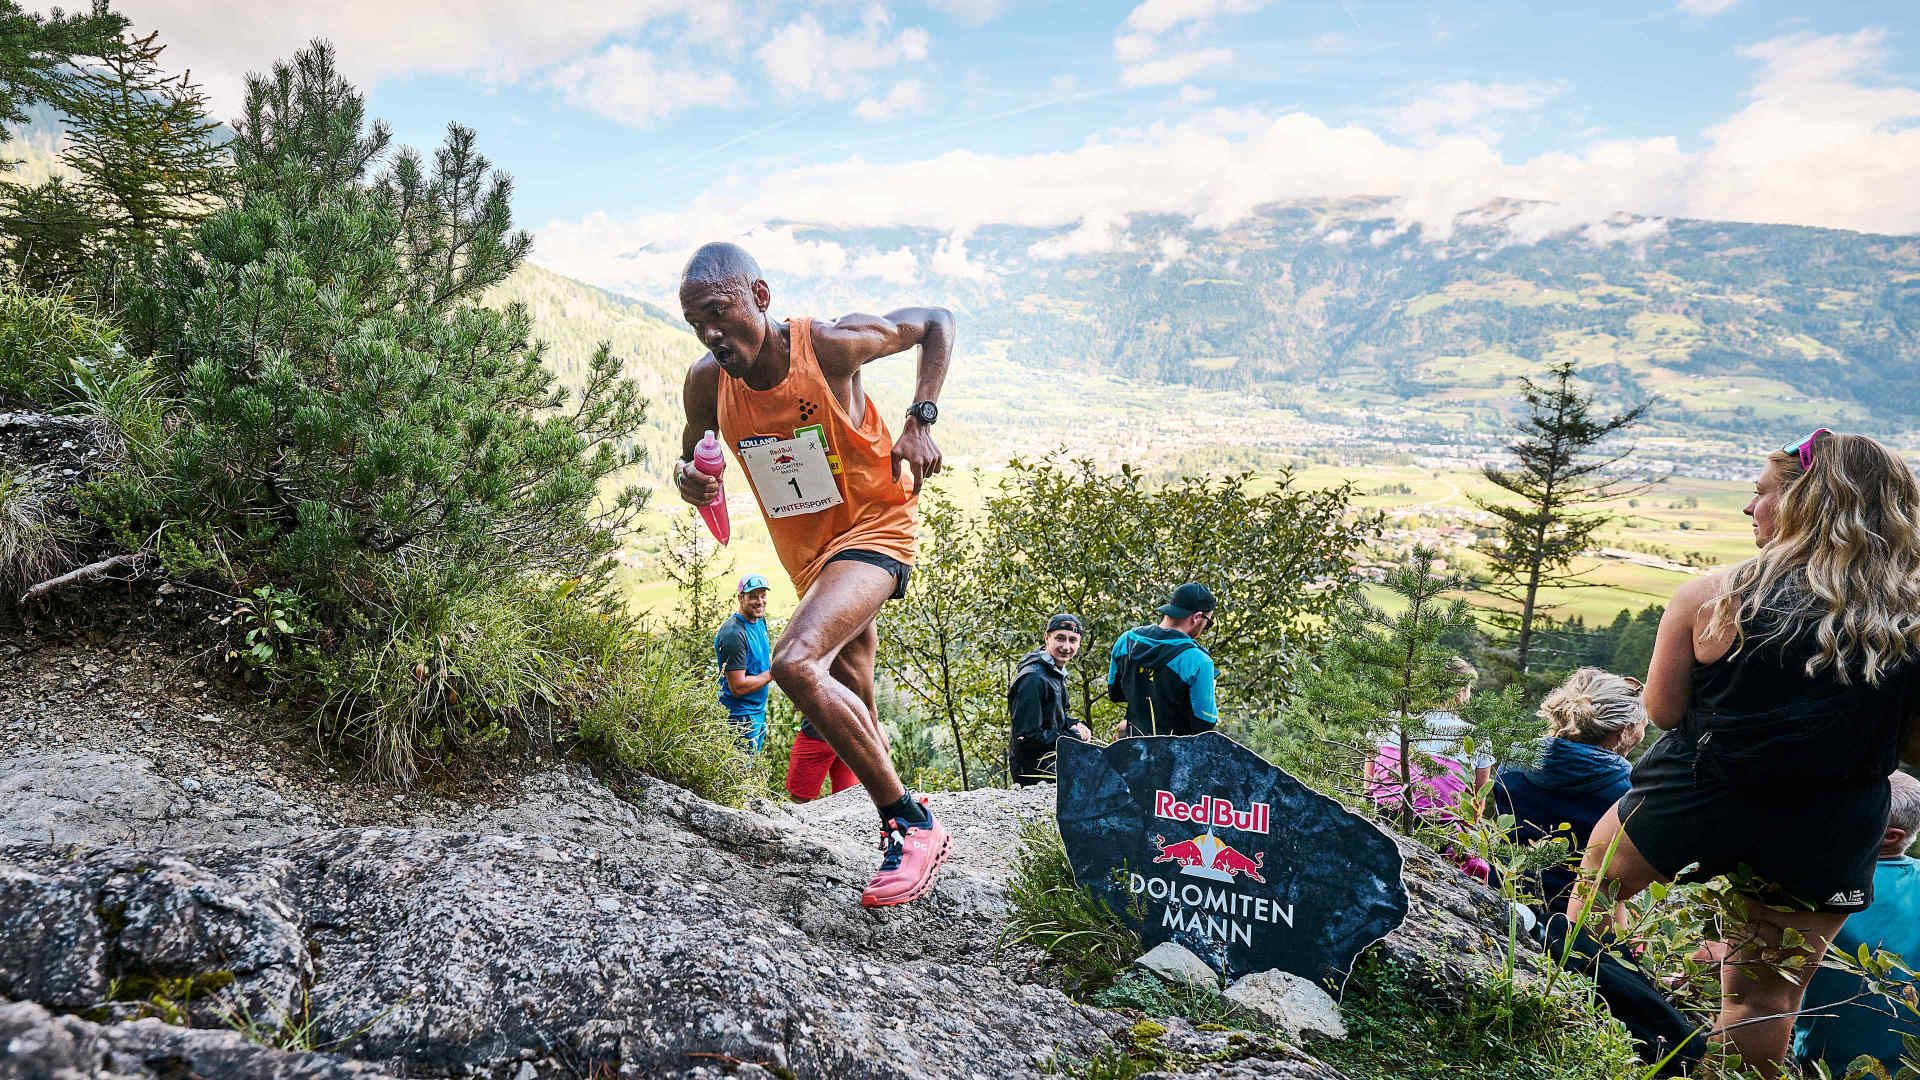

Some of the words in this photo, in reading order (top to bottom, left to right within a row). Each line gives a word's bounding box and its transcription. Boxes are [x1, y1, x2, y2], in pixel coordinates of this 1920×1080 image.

[788, 477, 803, 499] 1
[780, 497, 832, 512] INTERSPORT
[1129, 873, 1294, 928] DOLOMITEN
[1161, 905, 1252, 948] MANN
